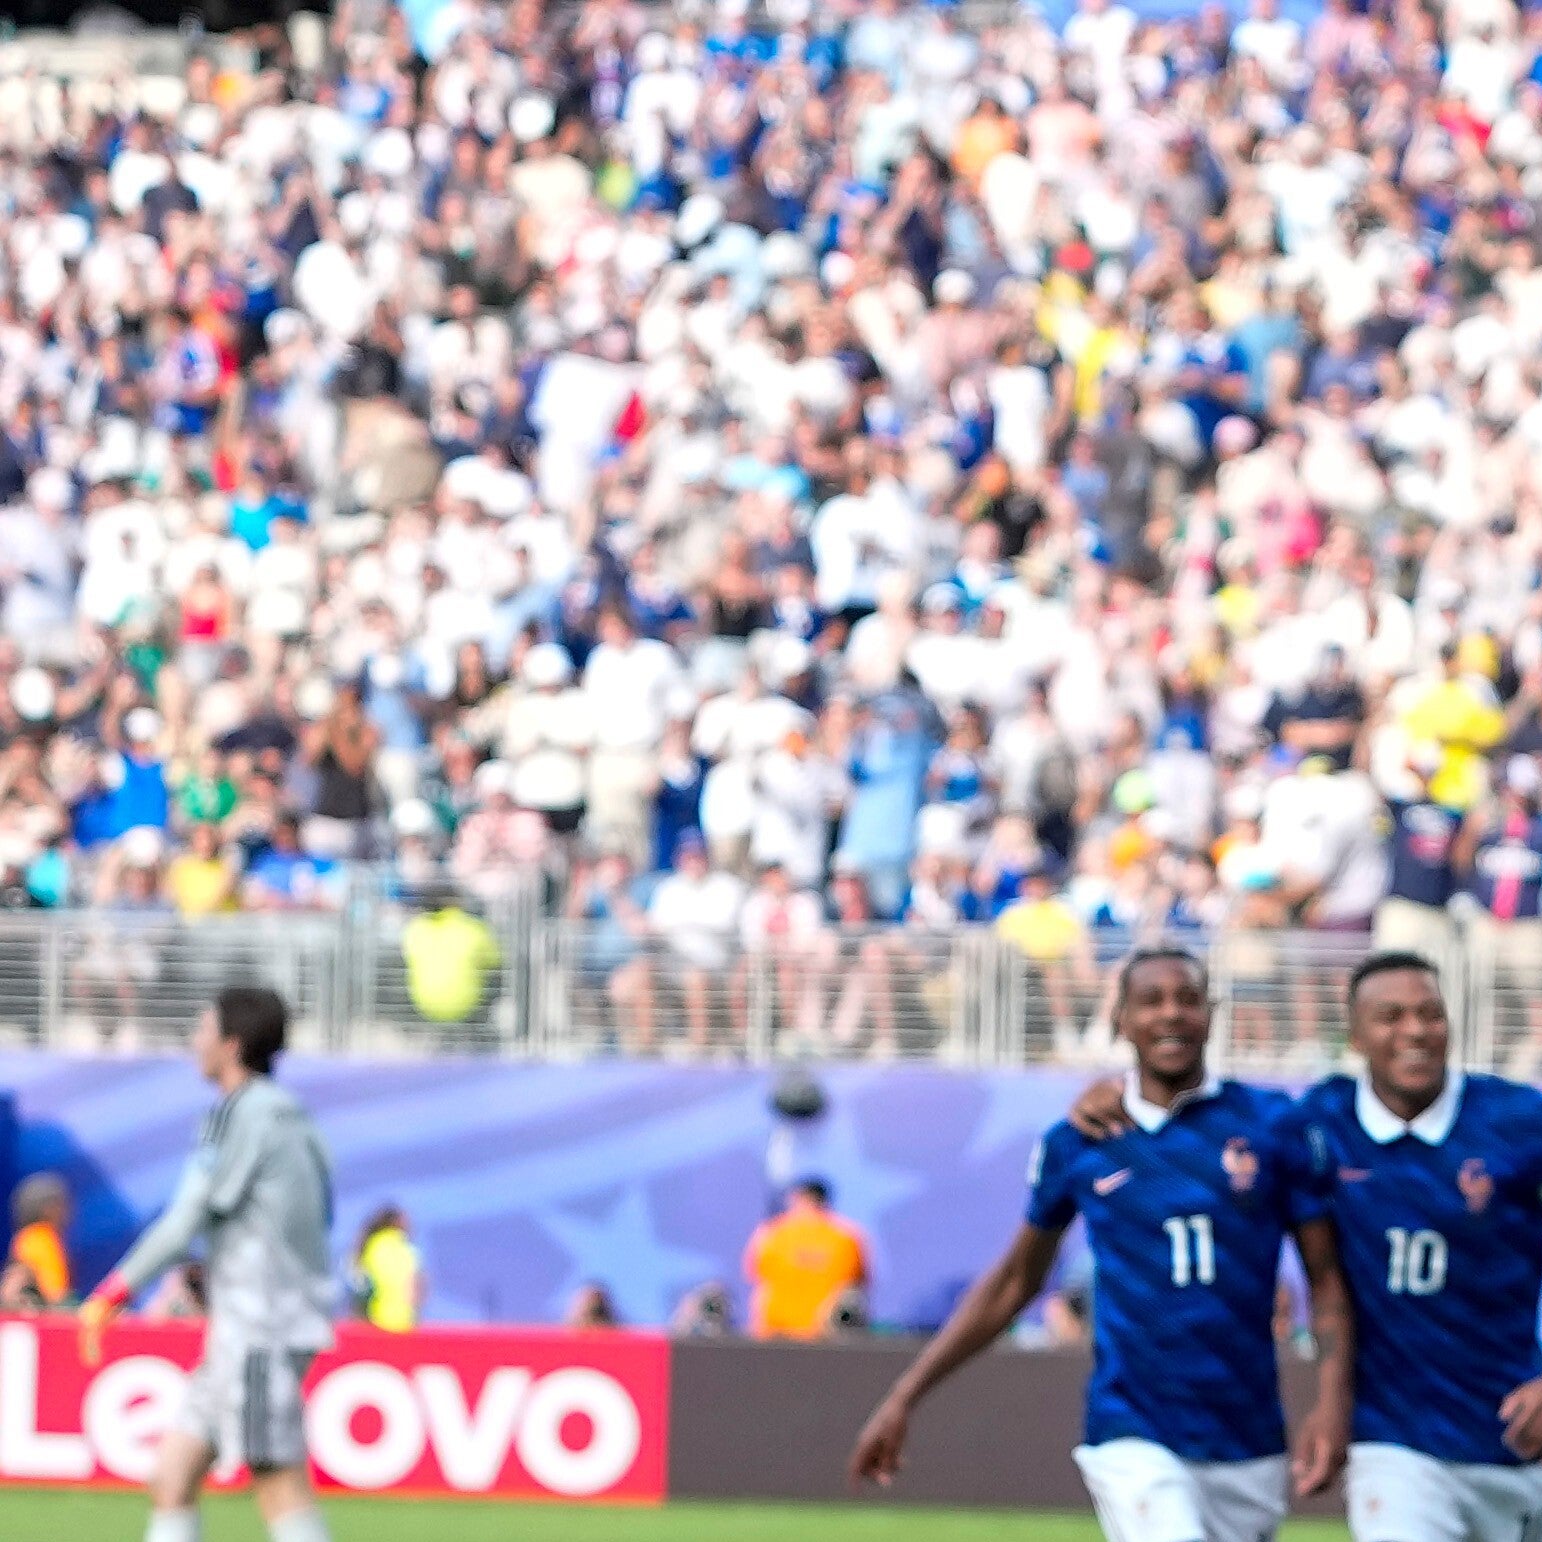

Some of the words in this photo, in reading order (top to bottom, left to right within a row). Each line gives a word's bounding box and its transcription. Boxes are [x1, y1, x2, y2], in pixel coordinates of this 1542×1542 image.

[1161, 1213, 1216, 1287] 11
[1385, 1226, 1449, 1295] 10
[0, 1319, 641, 1497] Leovo
